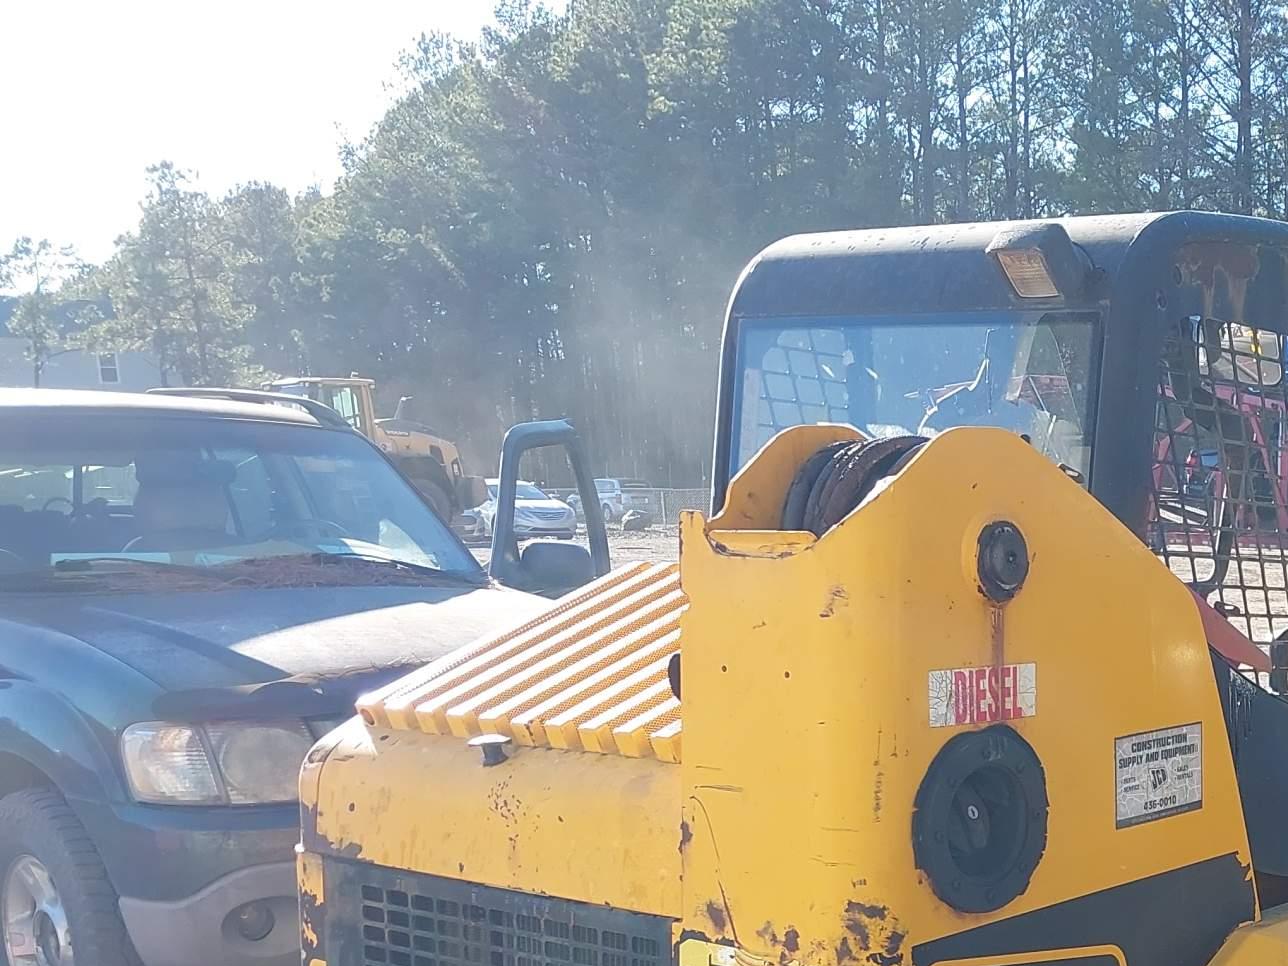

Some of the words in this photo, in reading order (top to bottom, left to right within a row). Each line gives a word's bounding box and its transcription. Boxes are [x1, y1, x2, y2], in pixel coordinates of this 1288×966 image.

[953, 666, 1023, 723] DIESEL
[1131, 733, 1187, 753] CONSTRUCTION
[1118, 755, 1143, 769] SUPPLY
[1145, 751, 1159, 763] AND
[1161, 744, 1195, 760] EQUIPMENT
[1151, 768, 1168, 790] JCB
[1143, 795, 1177, 810] 436-0010
